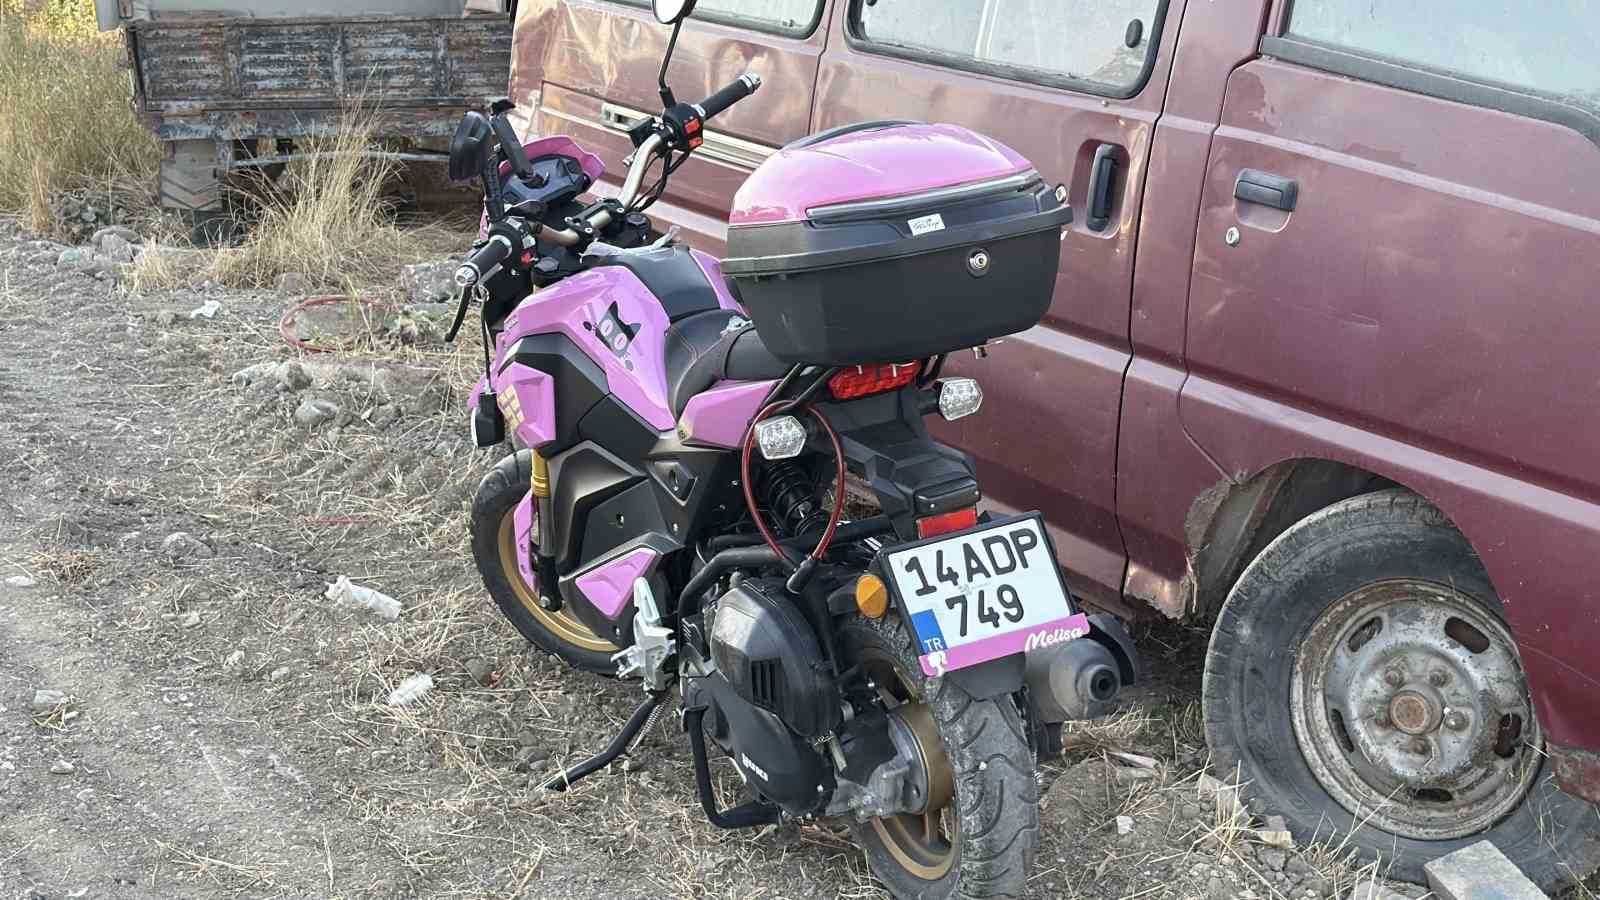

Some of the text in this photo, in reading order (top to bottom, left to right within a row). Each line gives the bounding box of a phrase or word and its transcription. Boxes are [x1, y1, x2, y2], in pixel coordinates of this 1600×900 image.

[905, 528, 1038, 597] 14ADP
[945, 584, 1025, 637] 749
[923, 637, 944, 652] TR
[1024, 628, 1083, 652] Melisa
